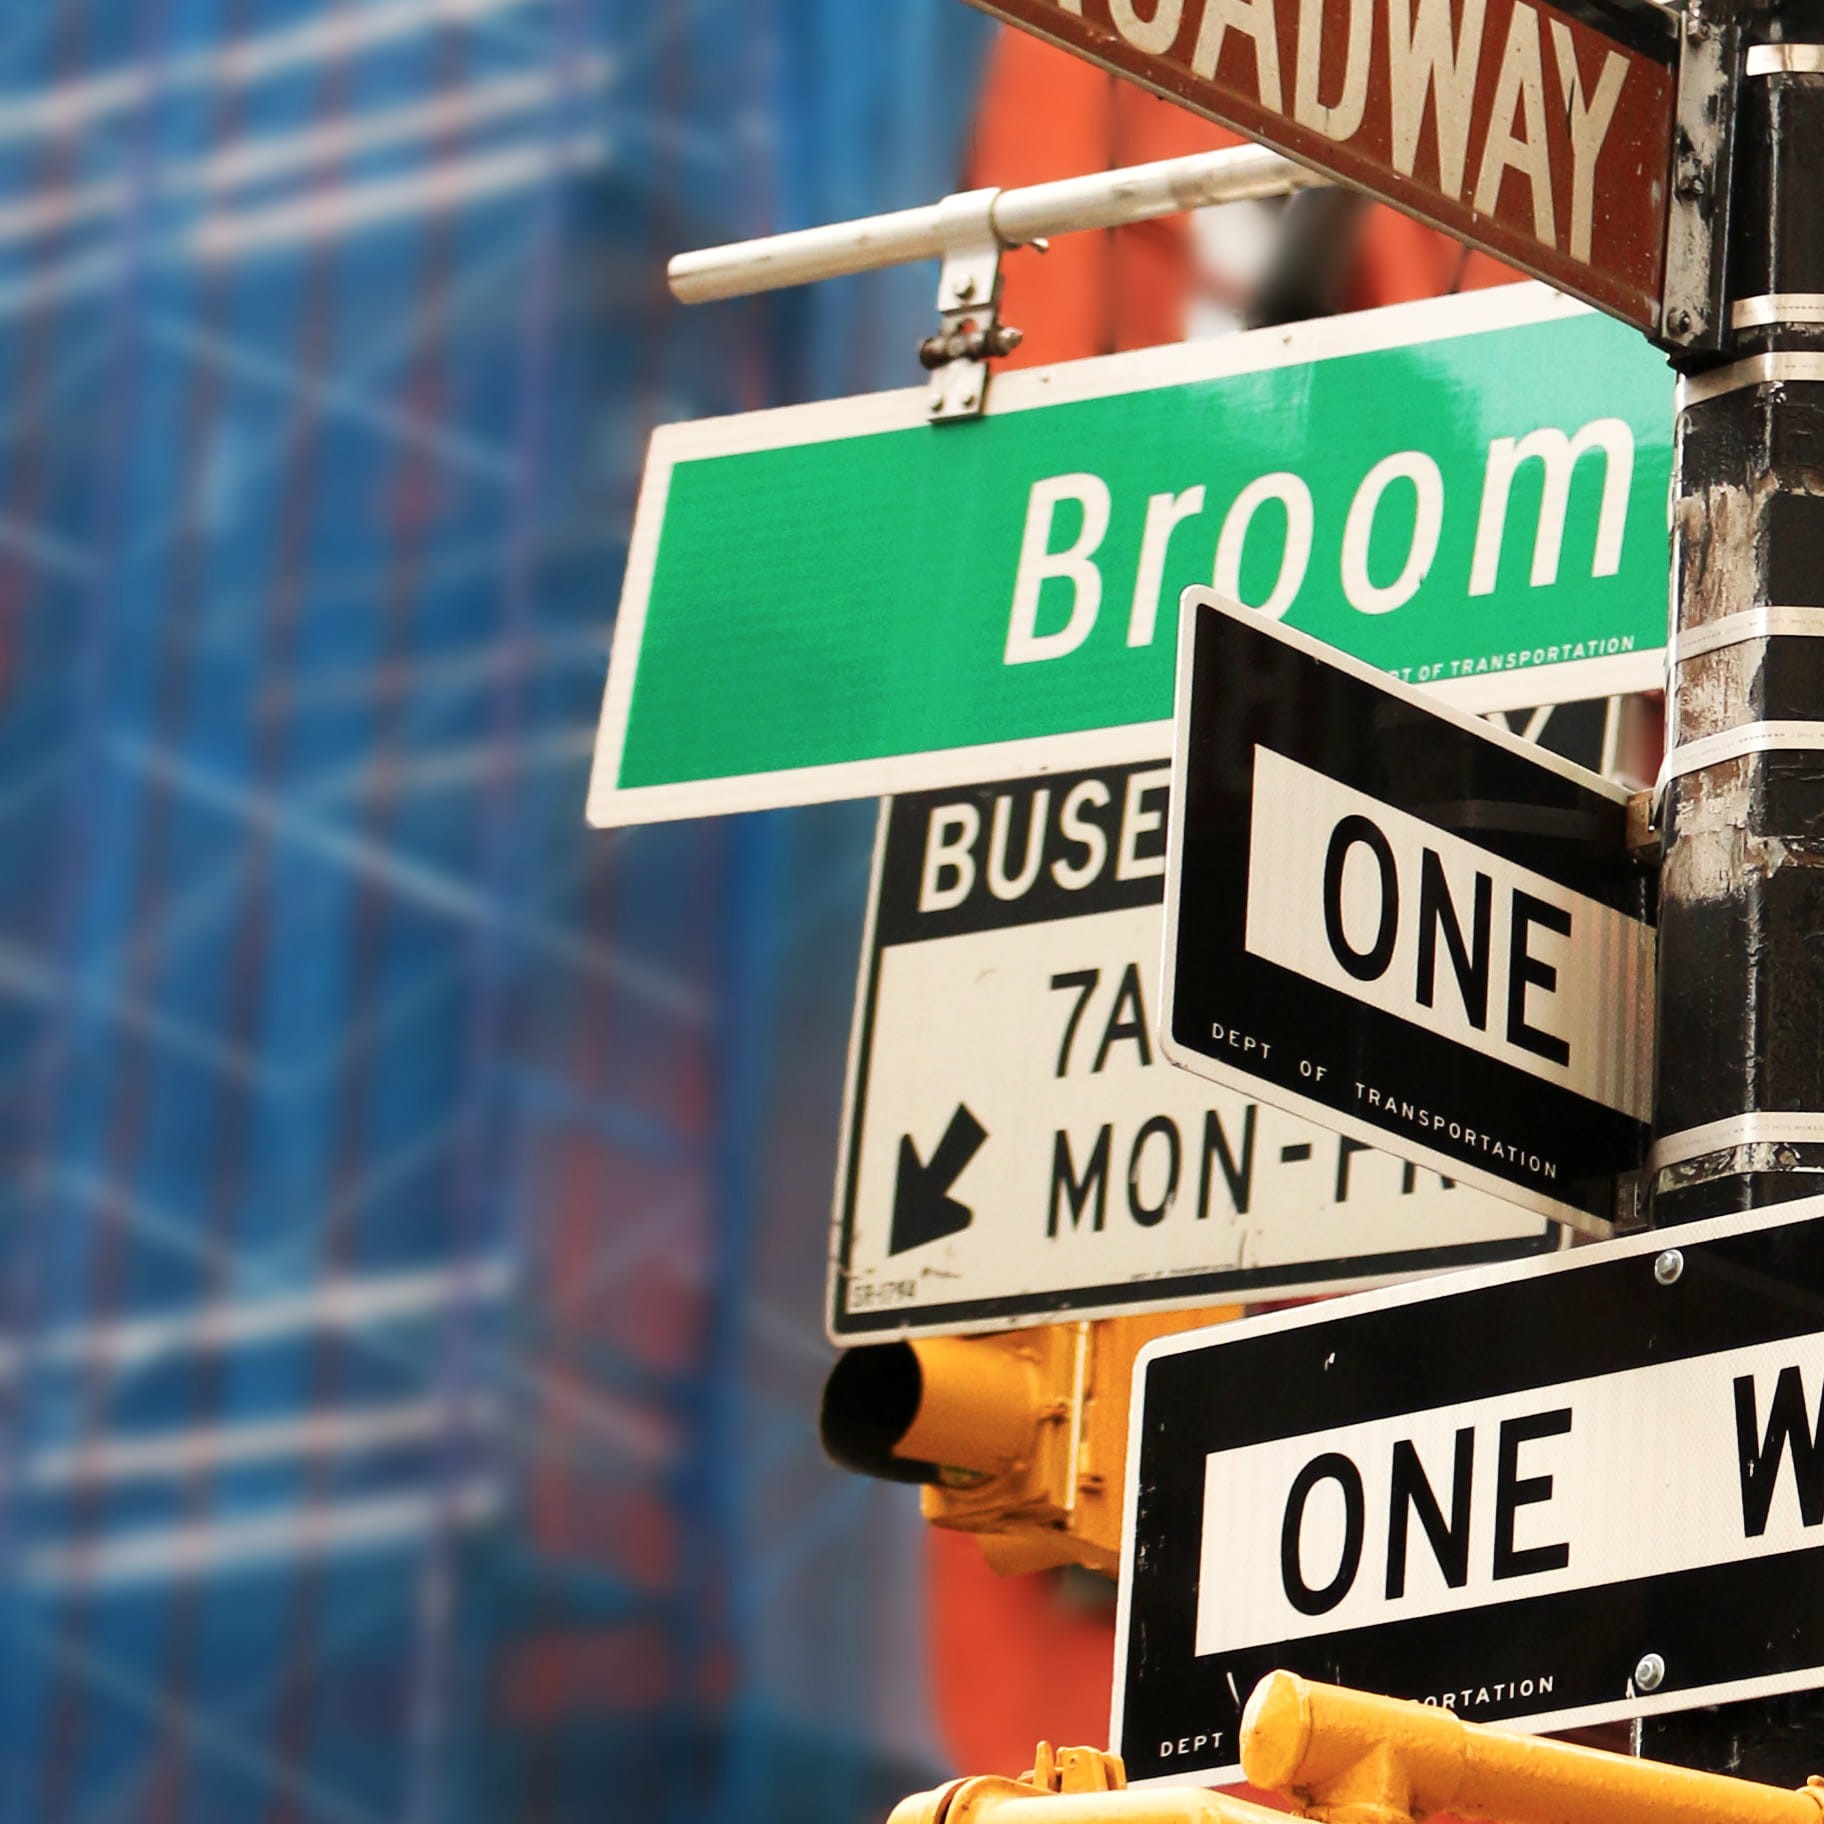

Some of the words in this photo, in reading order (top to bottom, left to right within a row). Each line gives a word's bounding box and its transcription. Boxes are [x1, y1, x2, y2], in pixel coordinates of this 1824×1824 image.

[1003, 417, 1636, 667] Broom
[1417, 662, 1444, 682] OF
[1451, 635, 1635, 676] TRANSPORTATION
[918, 767, 1172, 914] BUSE
[1322, 813, 1572, 1068] ONE
[1048, 961, 1153, 1079] 7A
[1211, 1022, 1273, 1059] DEPT
[1299, 1060, 1328, 1082] OF
[1353, 1081, 1557, 1179] TRANSPORTATION
[1281, 1407, 1571, 1617] ONE
[1159, 1731, 1224, 1759] DEPT
[1414, 1675, 1554, 1710] ORTATION
